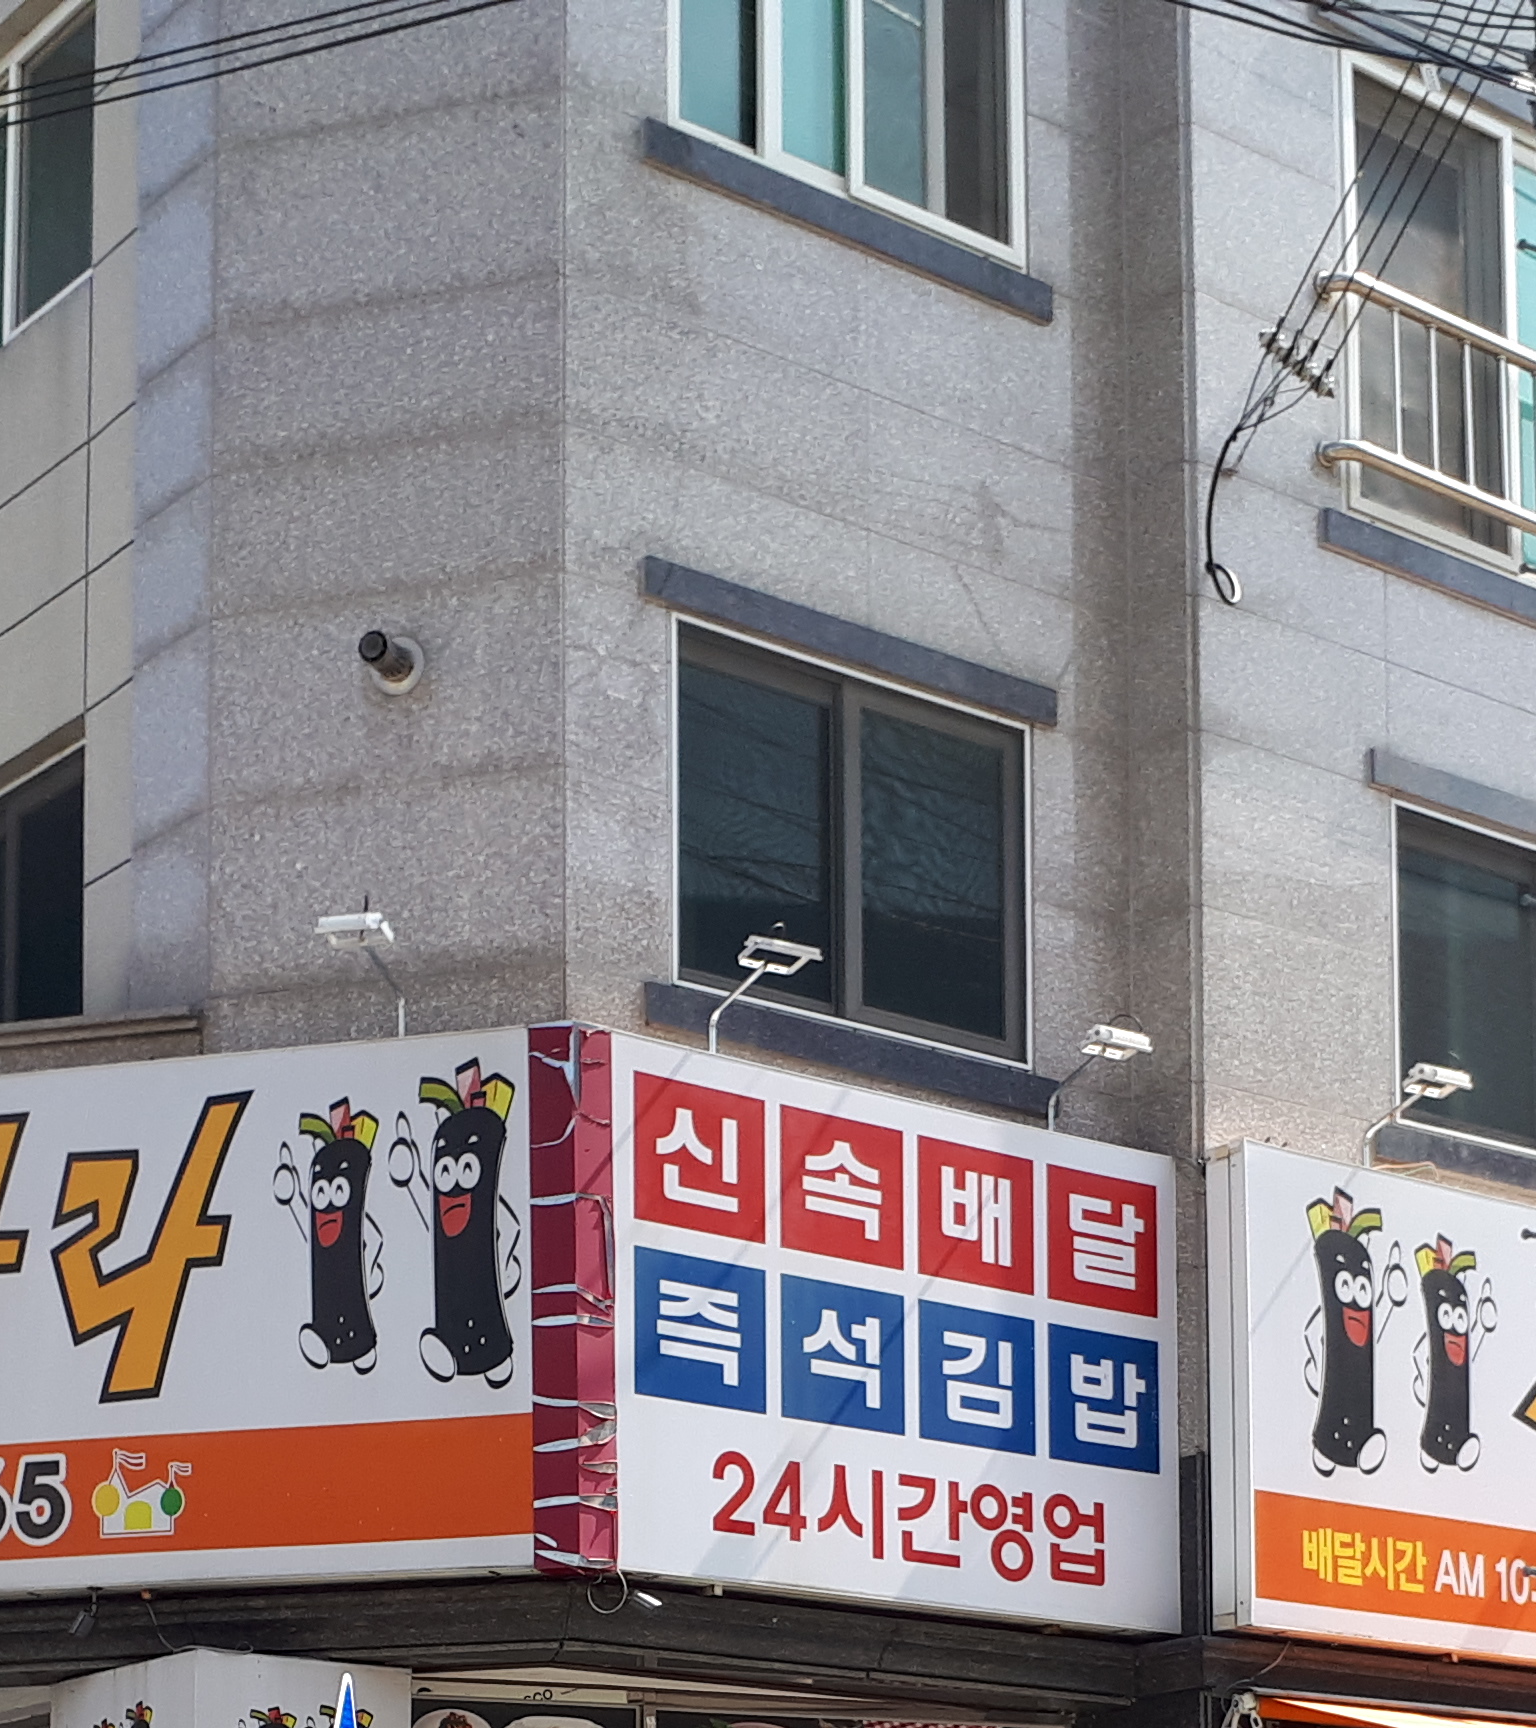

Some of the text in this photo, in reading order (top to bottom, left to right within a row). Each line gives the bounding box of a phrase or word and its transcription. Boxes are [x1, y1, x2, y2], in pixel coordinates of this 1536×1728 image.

[711, 1450, 1106, 1587] 24시간영업
[1301, 1527, 1428, 1594] 배달시간
[1434, 1549, 1486, 1598] AM
